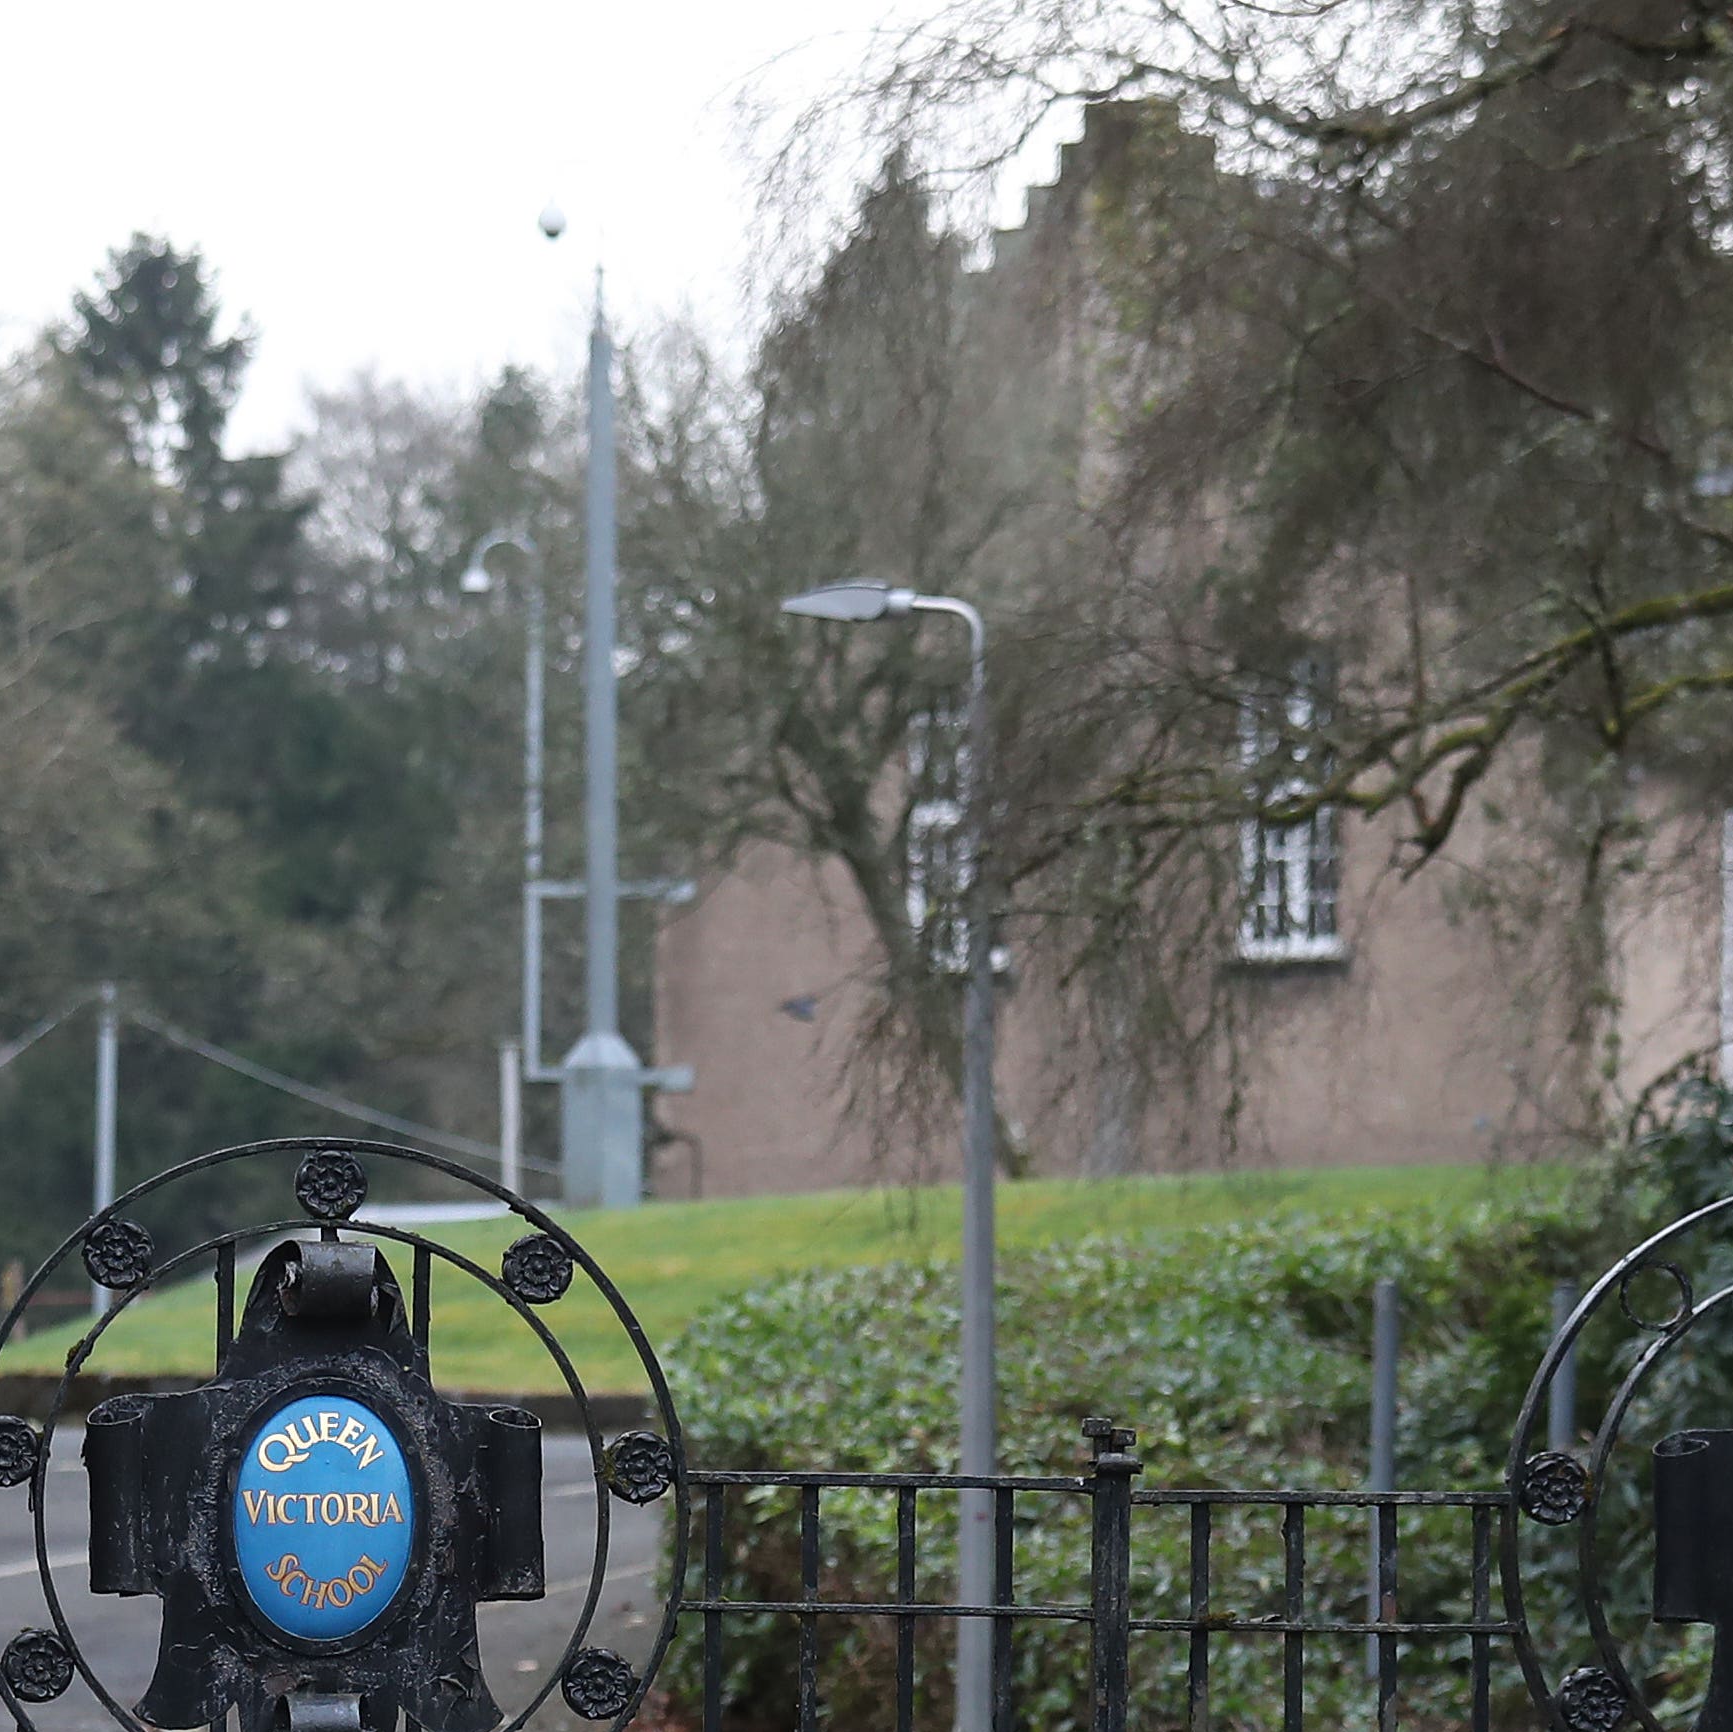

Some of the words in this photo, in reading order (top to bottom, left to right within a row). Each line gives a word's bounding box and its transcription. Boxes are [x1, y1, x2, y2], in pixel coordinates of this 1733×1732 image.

[256, 1411, 384, 1473] QUEEN
[241, 1490, 404, 1528] VICTORIA
[264, 1553, 389, 1610] SCHOOL
